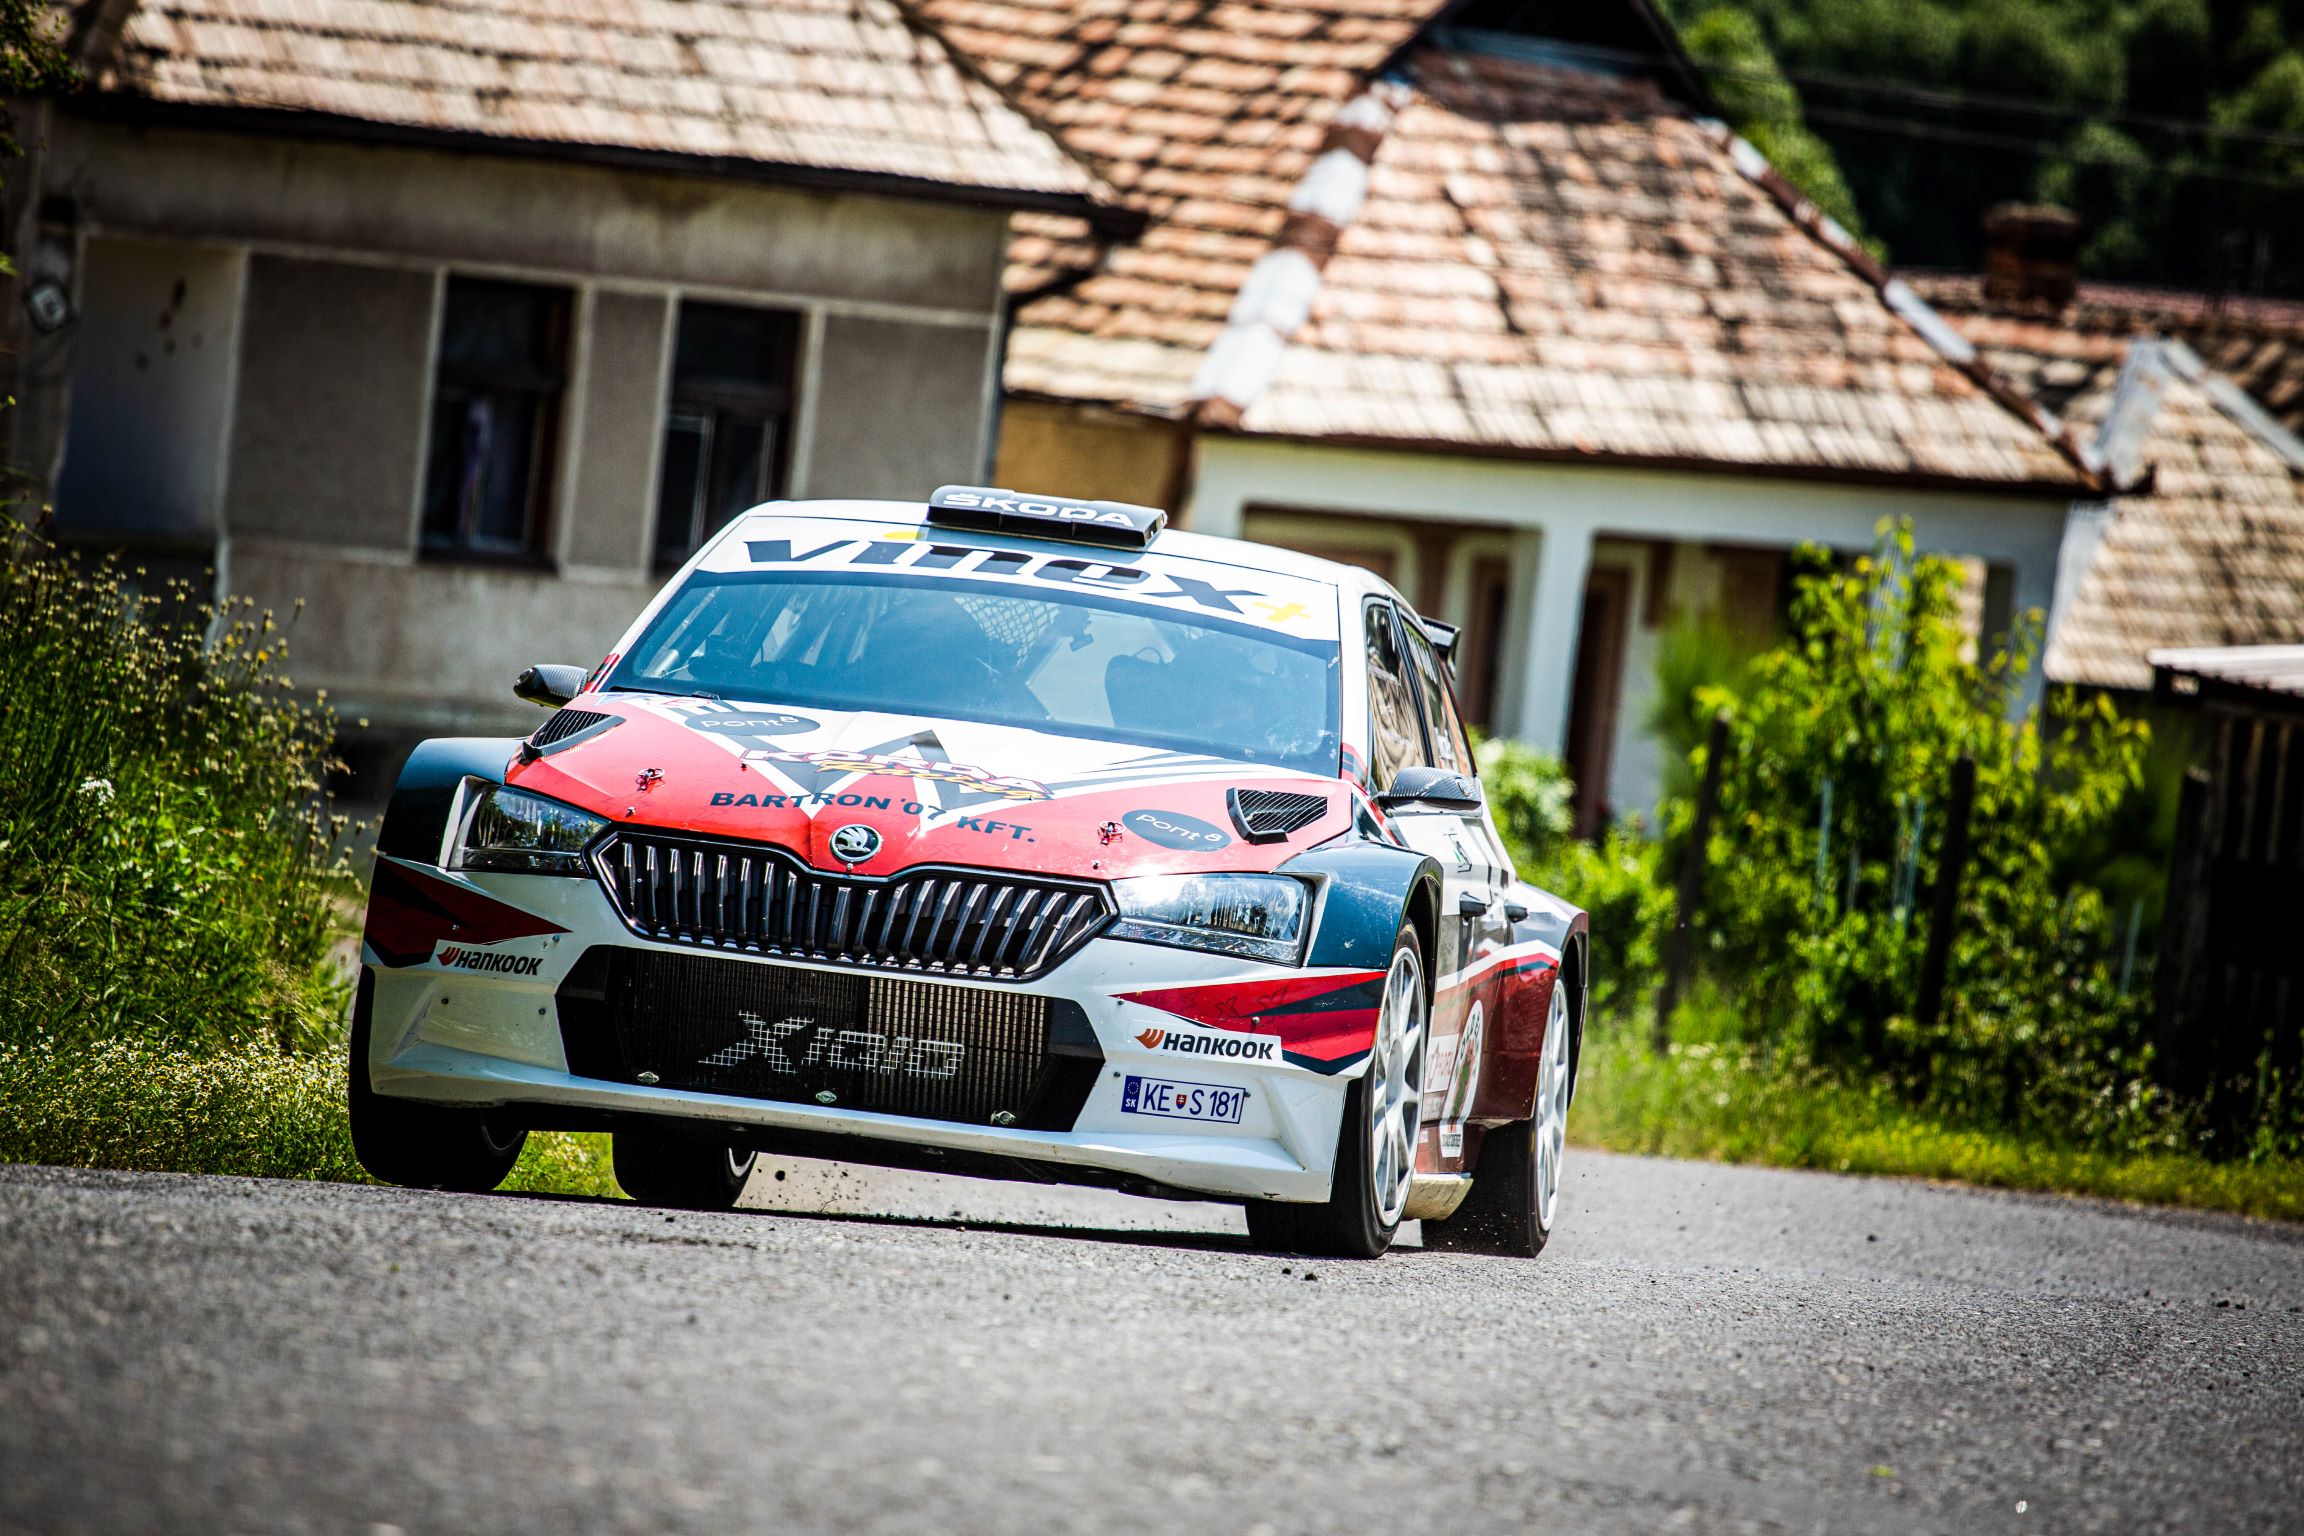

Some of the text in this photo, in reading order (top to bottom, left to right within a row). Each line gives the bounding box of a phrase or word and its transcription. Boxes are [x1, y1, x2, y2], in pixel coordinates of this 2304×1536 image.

[942, 493, 1135, 528] ŠKODA
[710, 792, 891, 810] BARTRON
[956, 815, 1036, 844] KFT.
[1125, 1098, 1137, 1108] SK
